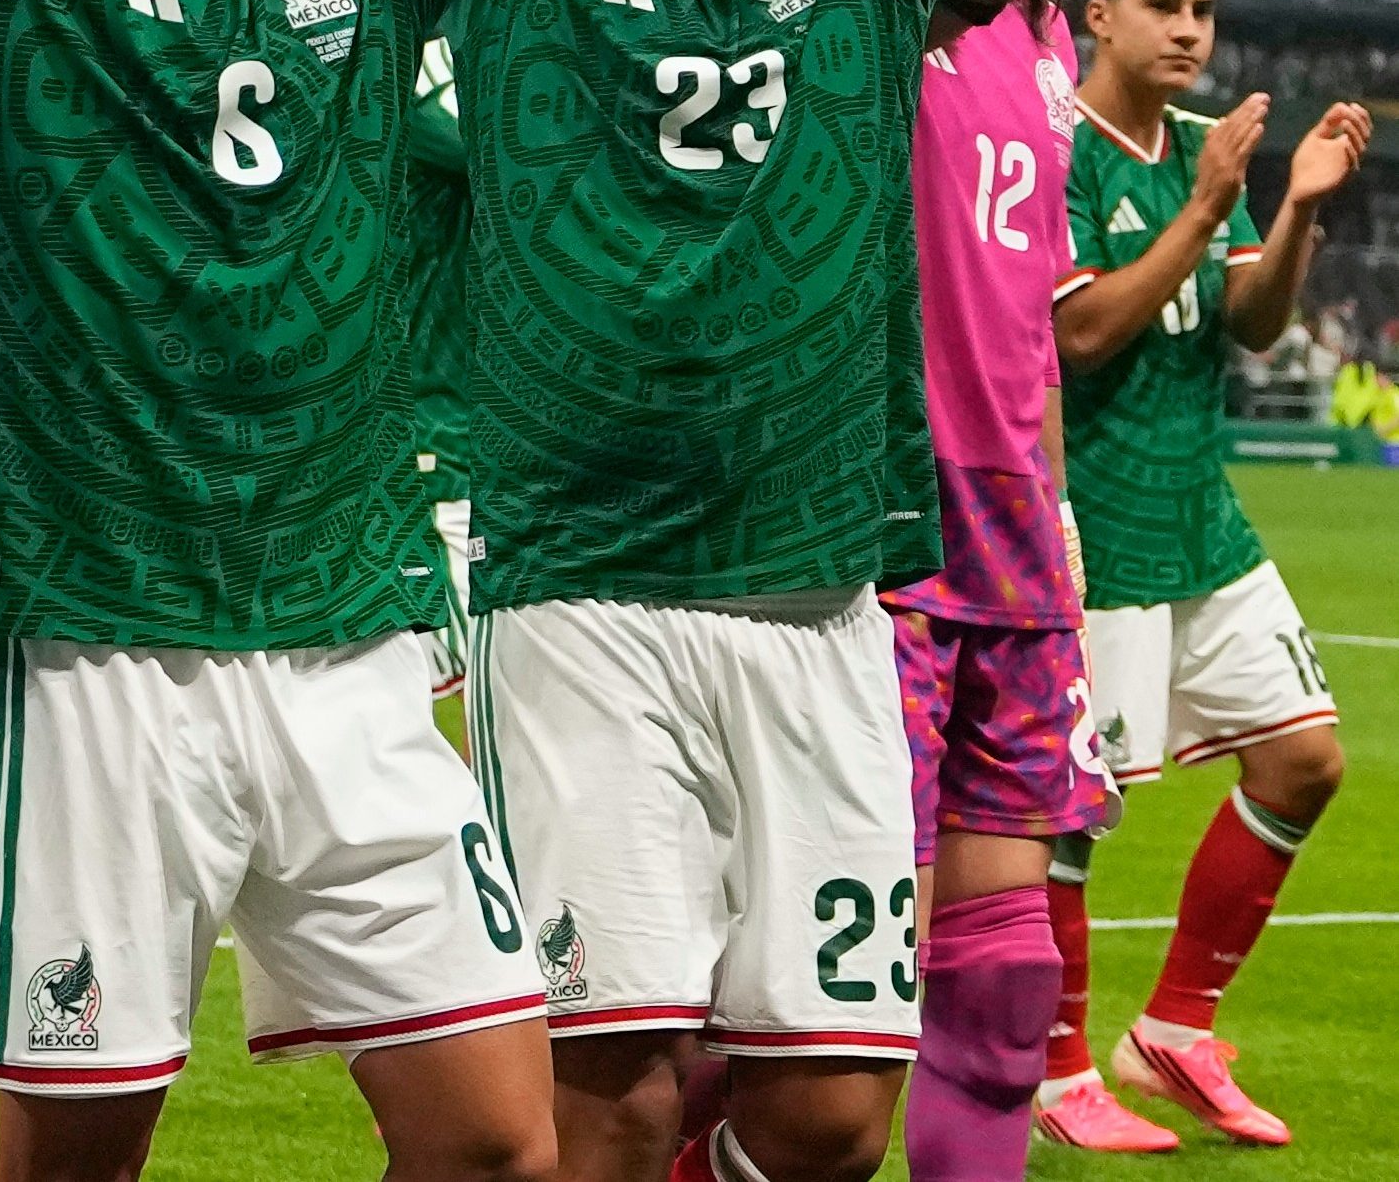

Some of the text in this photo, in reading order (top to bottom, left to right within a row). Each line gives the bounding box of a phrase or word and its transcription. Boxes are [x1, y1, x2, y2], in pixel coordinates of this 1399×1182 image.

[211, 60, 284, 187] 6
[655, 48, 786, 171] 23
[974, 132, 1037, 253] 12
[461, 821, 522, 954] 6
[814, 877, 916, 1002] 23
[30, 1029, 96, 1048] MÉXICO
